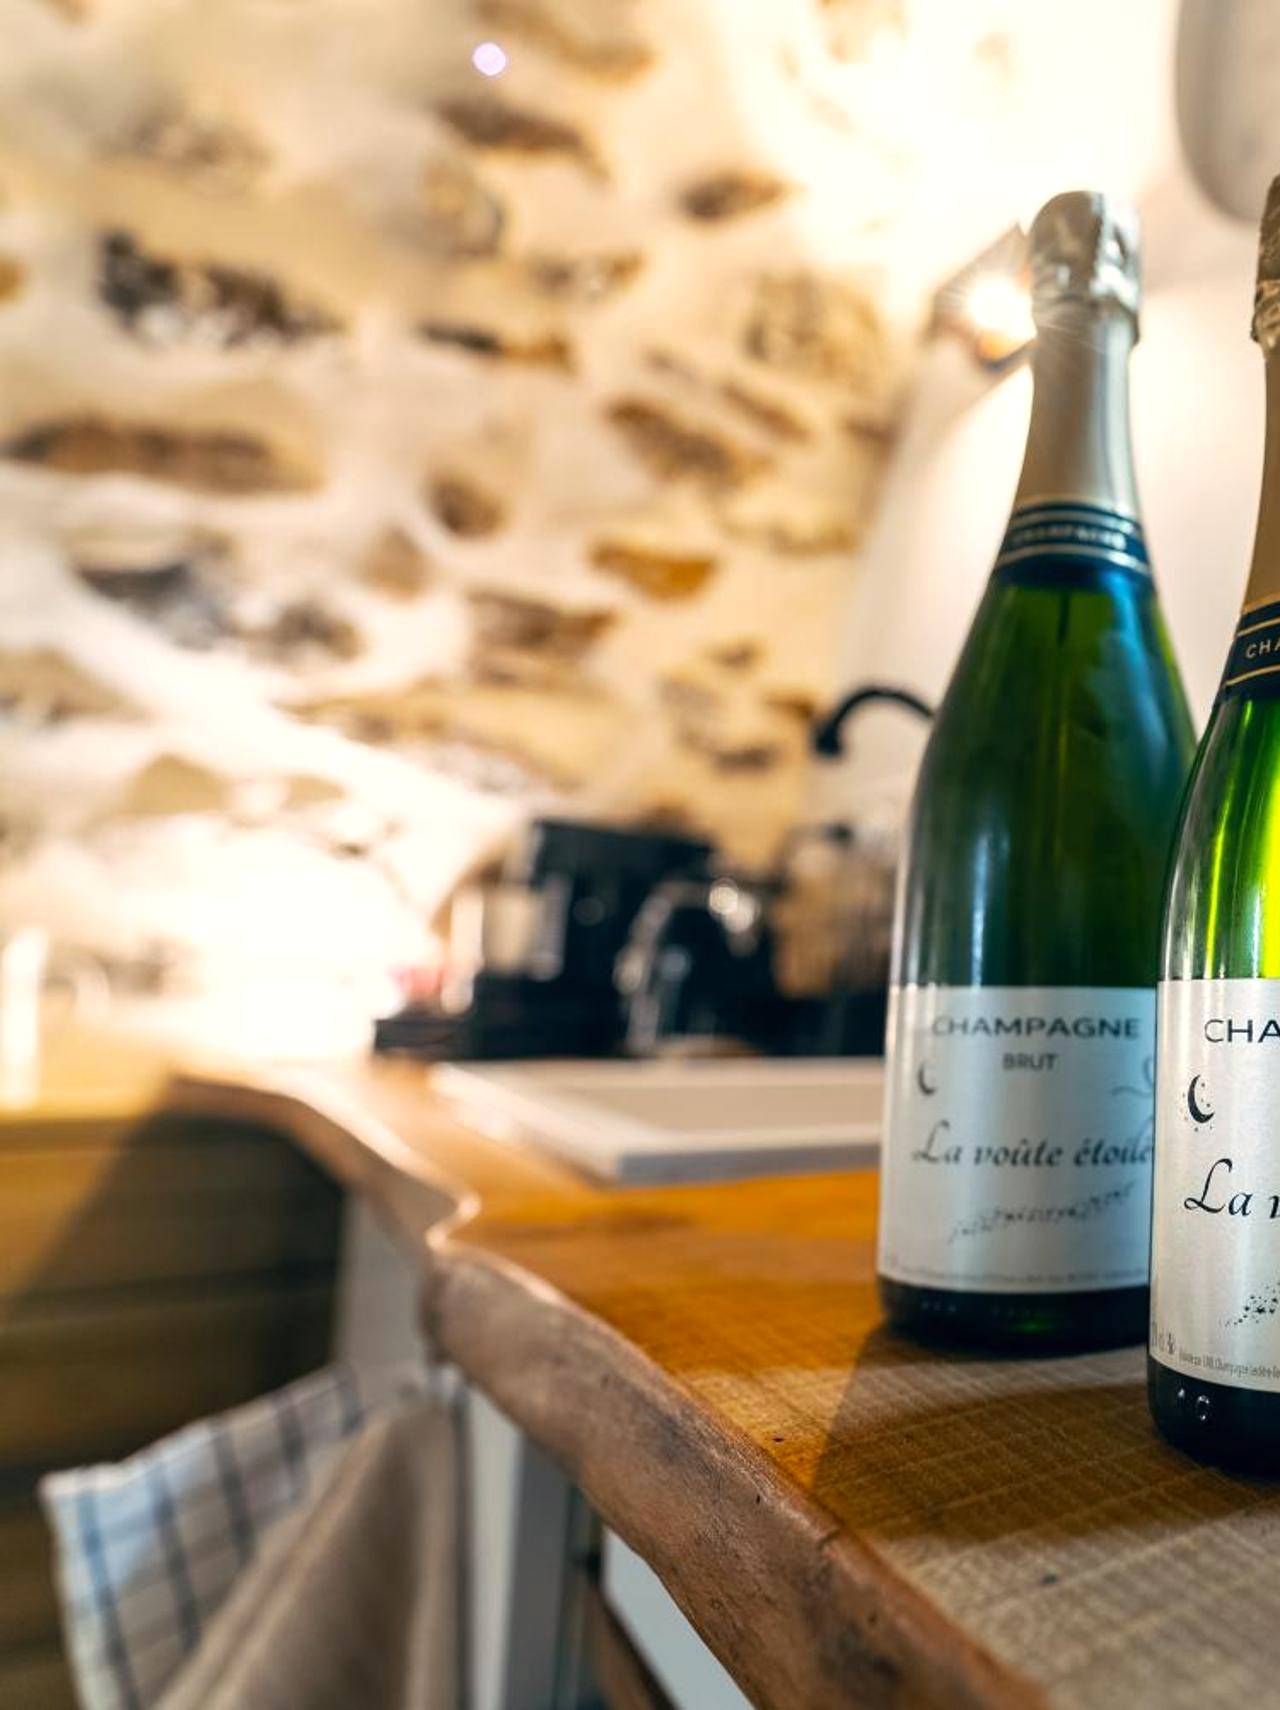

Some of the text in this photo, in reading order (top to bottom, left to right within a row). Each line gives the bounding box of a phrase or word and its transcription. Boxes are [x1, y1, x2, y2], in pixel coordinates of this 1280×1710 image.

[932, 1017, 1142, 1039] CHAMPAGNE
[1003, 1053, 1058, 1071] BRUT
[912, 1119, 962, 1164] La
[974, 1138, 1063, 1166] voûte
[1183, 1158, 1253, 1216] La
